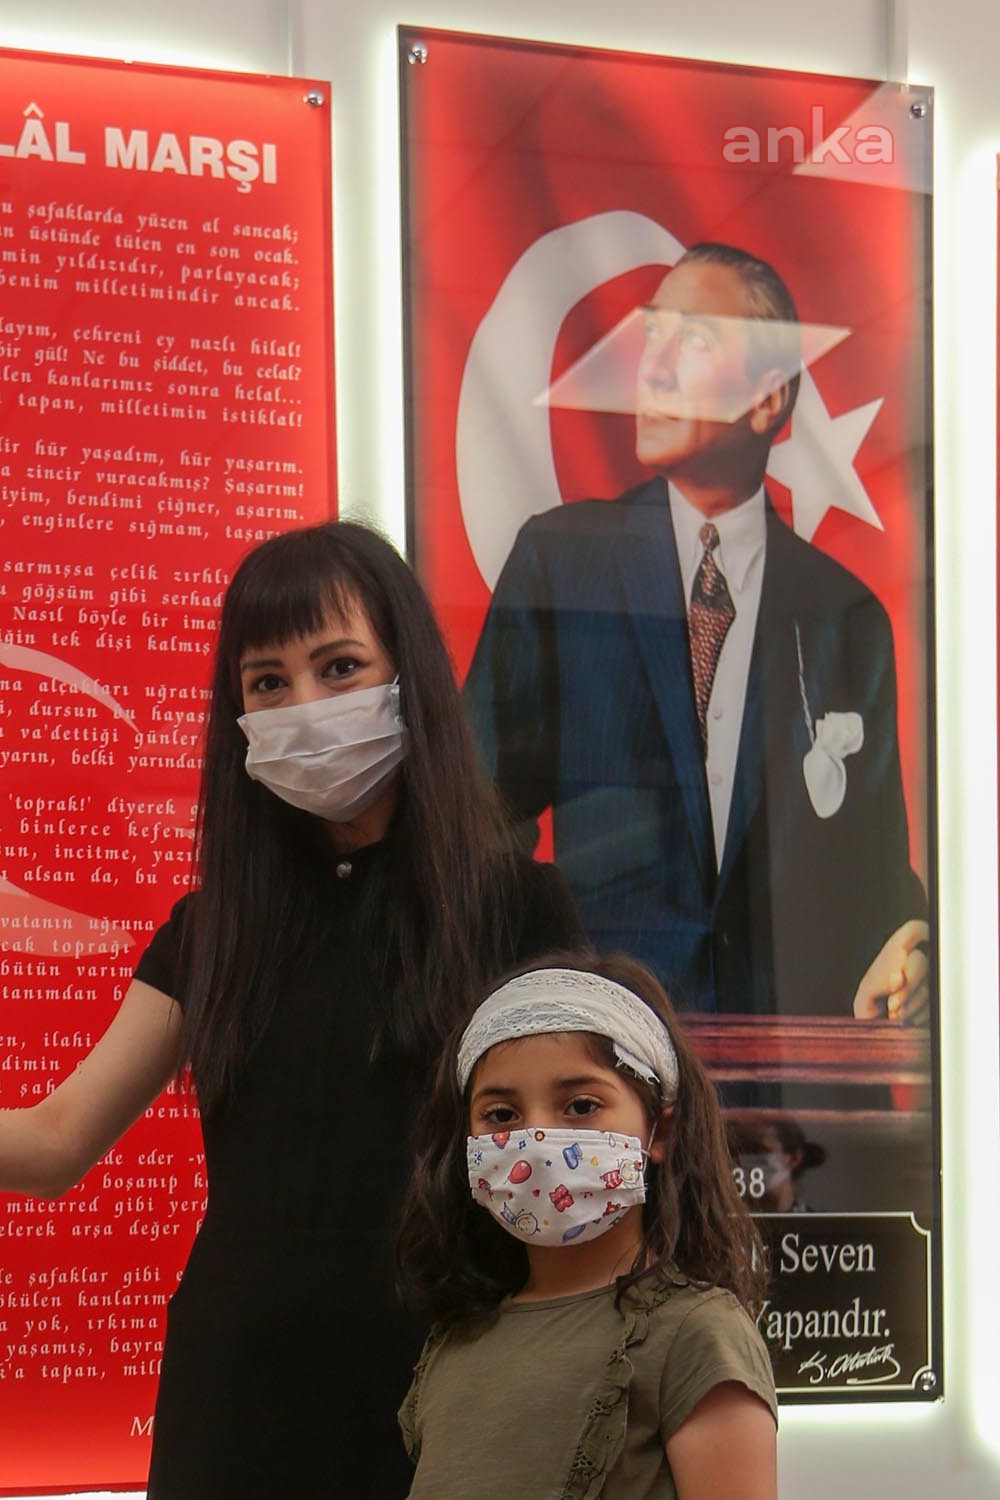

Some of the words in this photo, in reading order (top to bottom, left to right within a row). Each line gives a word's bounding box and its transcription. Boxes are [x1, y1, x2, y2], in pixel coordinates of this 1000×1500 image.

[104, 126, 278, 194] MARŞI
[27, 202, 123, 224] şafaklarda
[136, 213, 188, 233] yüzen
[202, 217, 220, 233] al
[233, 224, 298, 243] sancak;
[29, 226, 100, 246] üstünde
[115, 235, 162, 252] tüten
[176, 242, 195, 255] en
[210, 246, 240, 259] son
[254, 247, 298, 264] ocak.
[57, 252, 164, 277] yıldızıdır,
[181, 265, 299, 290] parlayacak;
[75, 278, 219, 304] milletimindir
[234, 294, 299, 311] ancak.
[73, 325, 141, 344] çehreni
[156, 335, 175, 348] ey
[190, 336, 236, 352] nazlı
[251, 338, 301, 358] hilal!
[34, 345, 68, 367] gül!
[83, 349, 105, 365] Ne
[119, 351, 139, 368] bu
[153, 355, 208, 375] şiddet,
[223, 359, 243, 376] bu
[256, 363, 302, 381] celal?
[47, 369, 153, 393] kanlarımız
[168, 383, 220, 398] sonra
[235, 383, 301, 404] helal...
[18, 393, 83, 414] tapan,
[101, 398, 207, 420] milletimin
[222, 407, 302, 428] istiklal!
[35, 439, 67, 457] hür
[80, 446, 164, 466] yaşadım,
[180, 449, 211, 467] hür
[224, 458, 303, 475] yaşarım.
[26, 464, 81, 481] zincir
[96, 471, 210, 492] vuracakmış?
[224, 478, 304, 497] Şaşarım!
[67, 489, 142, 509] bendimi
[157, 497, 220, 518] çiğner,
[235, 505, 304, 520] aşarım.
[3, 561, 94, 578] sarmışsa
[110, 563, 158, 581] çelik
[173, 567, 231, 585] zırhlı
[7, 1195, 100, 1213] mücerred
[114, 1195, 154, 1219] gibi
[72, 1224, 113, 1239] arşa
[129, 1219, 180, 1242] değer
[780, 1232, 876, 1274] Seven
[28, 1266, 108, 1290] şafaklar
[122, 1265, 161, 1289] gibi
